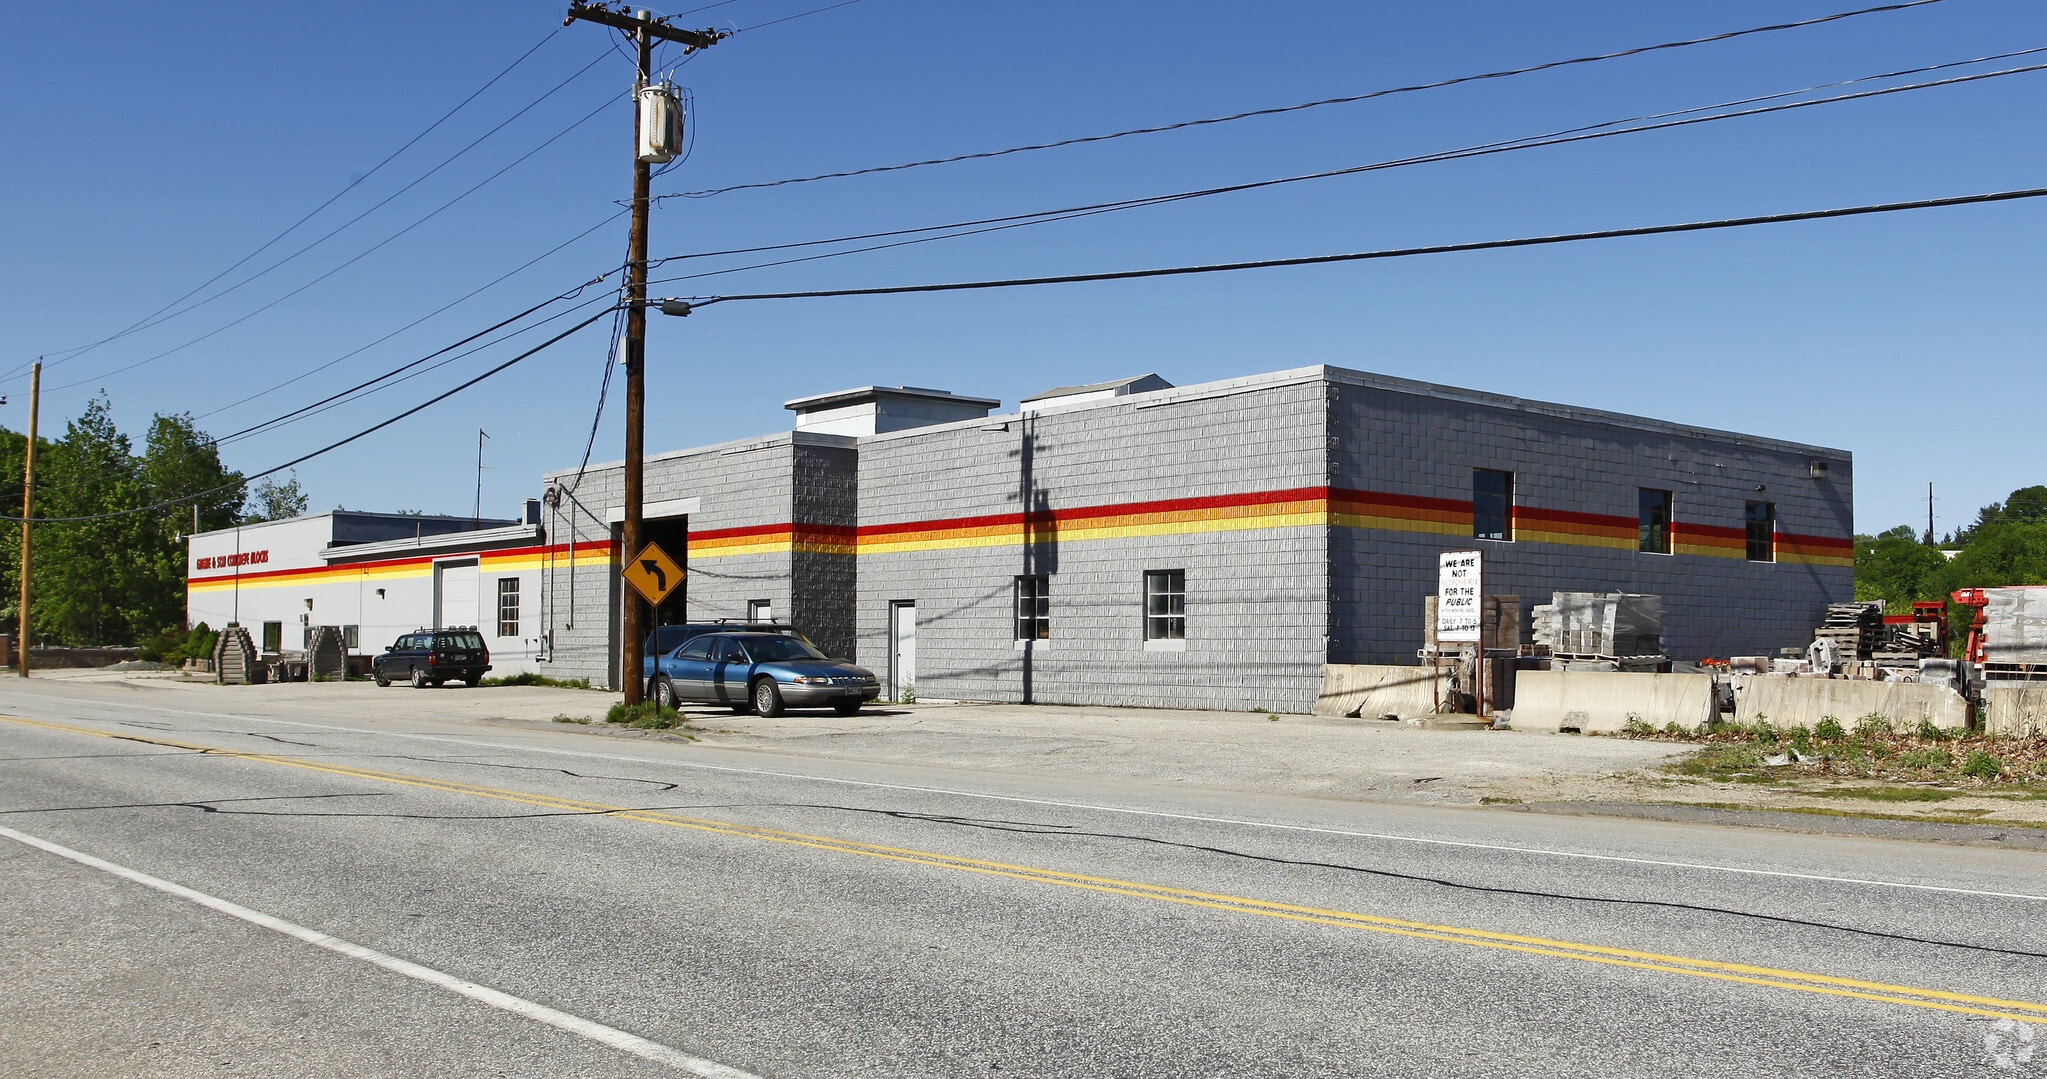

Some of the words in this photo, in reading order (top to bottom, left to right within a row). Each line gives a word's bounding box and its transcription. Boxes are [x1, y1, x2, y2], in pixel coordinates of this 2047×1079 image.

[1445, 560, 1457, 568] WE
[1460, 559, 1475, 567] ARE
[1445, 588, 1458, 596] FOR
[1460, 587, 1474, 595] THE
[1445, 598, 1473, 606] PUBLIC
